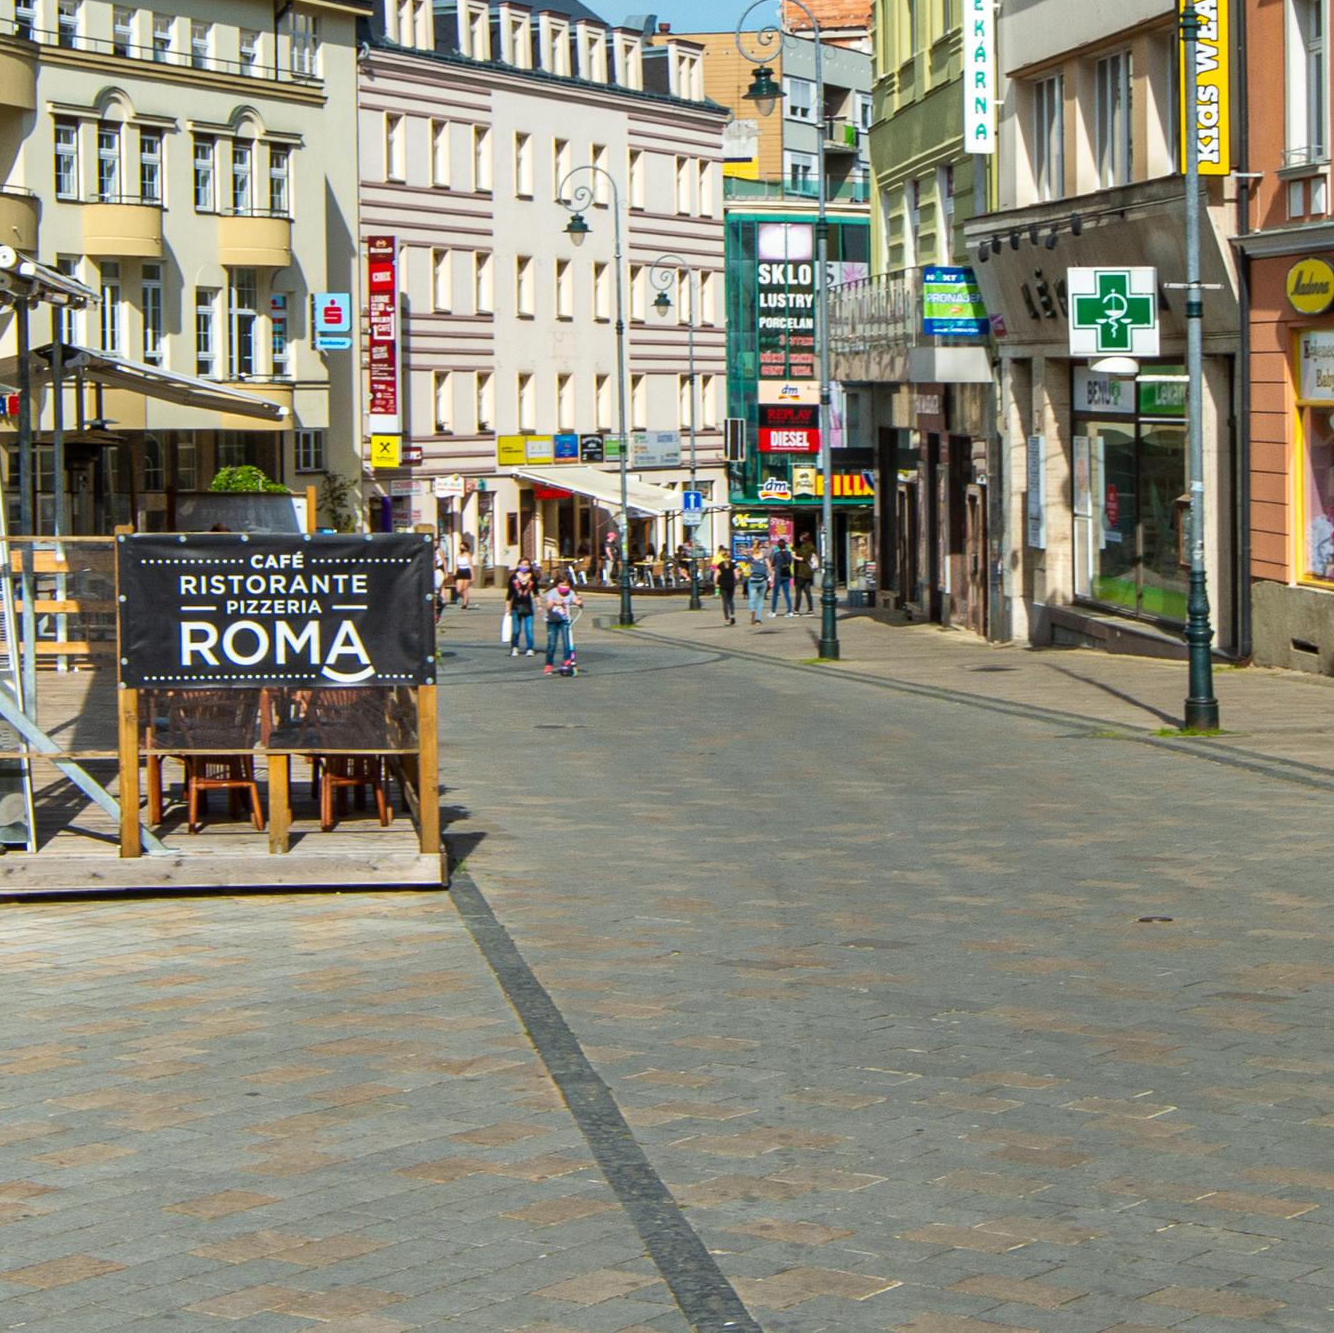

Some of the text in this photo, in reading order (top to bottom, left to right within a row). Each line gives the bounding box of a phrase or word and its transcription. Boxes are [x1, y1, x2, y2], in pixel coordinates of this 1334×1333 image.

[757, 263, 812, 285] SKLO
[759, 293, 814, 308] LUSTRY
[758, 317, 814, 329] PORCELAN
[768, 408, 812, 420] REPLAY
[769, 430, 811, 447] DIESEL
[250, 551, 304, 569] CAFÉ
[180, 574, 368, 595] RISTORANTE
[226, 599, 322, 614] PIZZERIA
[180, 620, 372, 666] ROMA
